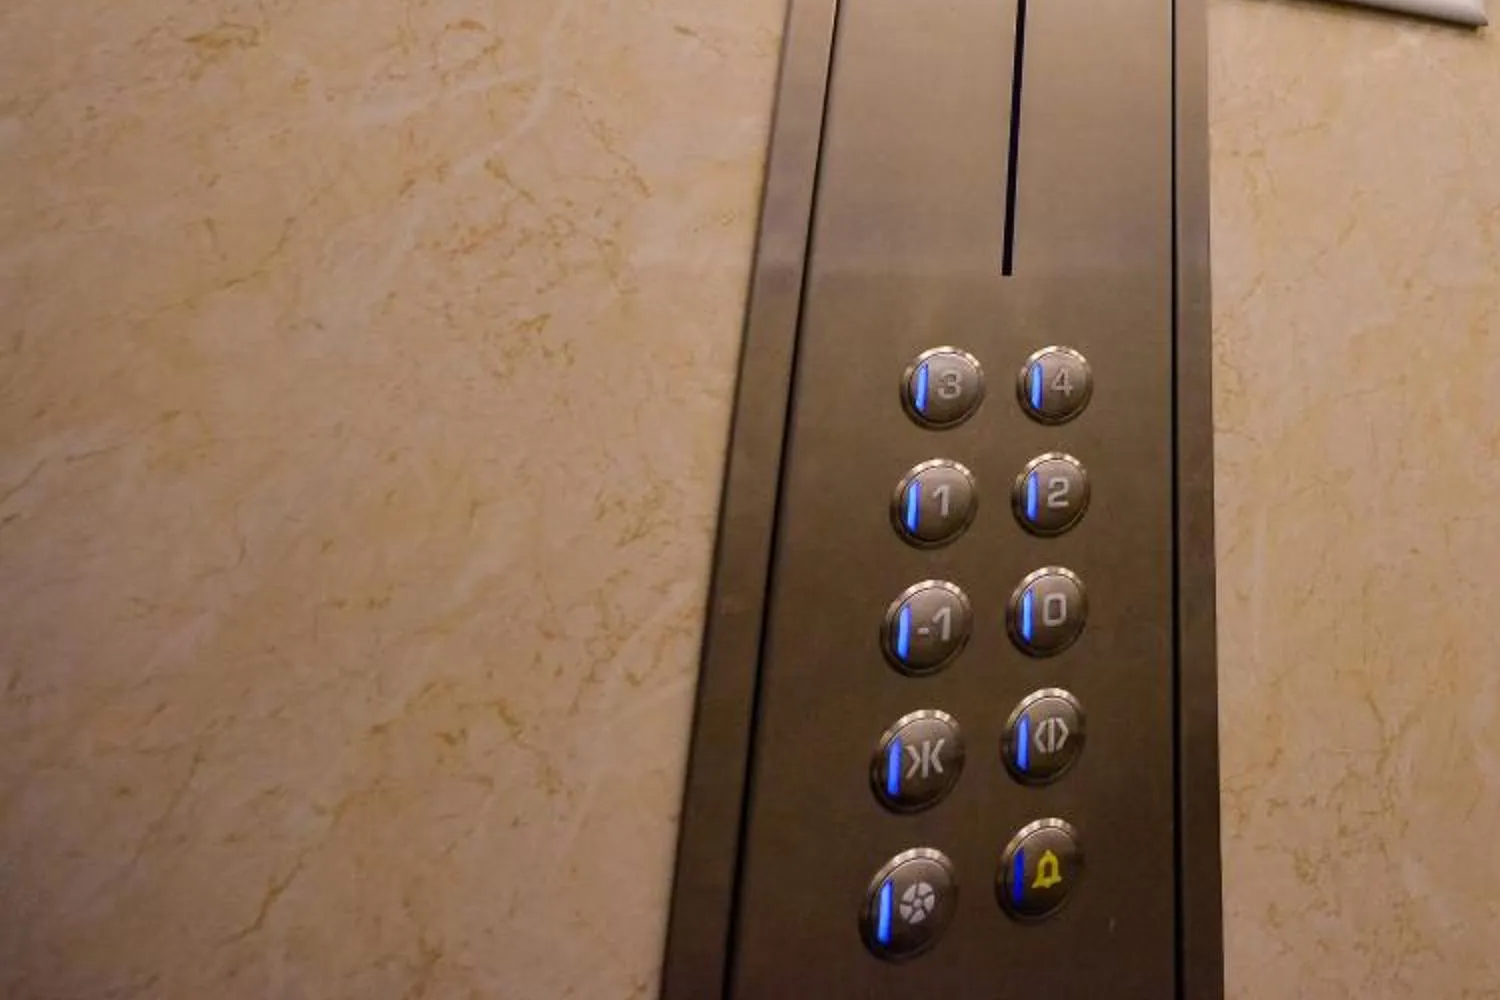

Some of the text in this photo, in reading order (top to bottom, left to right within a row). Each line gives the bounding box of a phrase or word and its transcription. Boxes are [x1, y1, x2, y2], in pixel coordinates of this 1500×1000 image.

[936, 371, 962, 400] 3
[1051, 368, 1073, 397] 4
[933, 484, 950, 517] 1
[1047, 477, 1069, 509] 2
[917, 607, 951, 641] -1
[1043, 593, 1067, 625] 0
